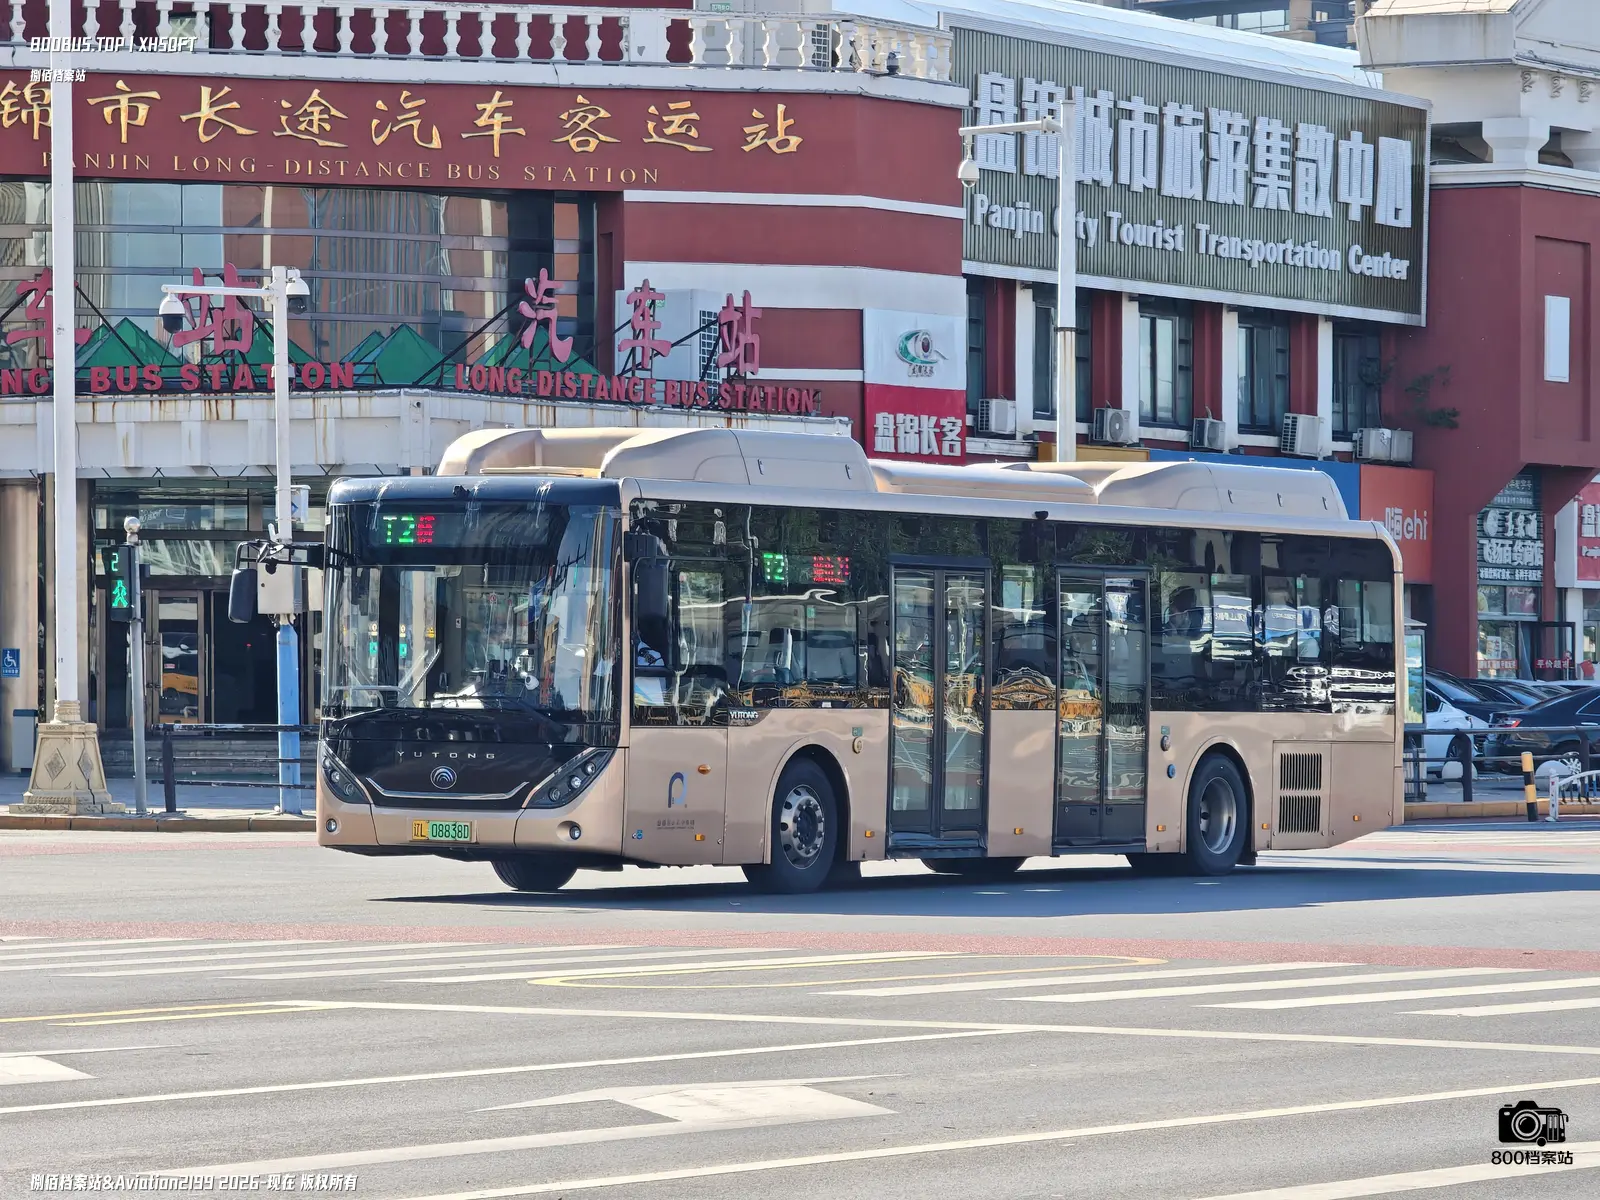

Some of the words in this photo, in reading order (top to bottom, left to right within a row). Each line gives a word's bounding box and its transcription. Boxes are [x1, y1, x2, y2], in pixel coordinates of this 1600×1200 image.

[0, 80, 803, 158] 锦市长途汽车客运站
[974, 72, 1412, 228] 盘锦城市旅游集散中心
[42, 152, 150, 170] PNJIN
[447, 163, 501, 181] BUS
[524, 166, 660, 184] STATION
[973, 193, 1044, 239] Panjin
[1052, 206, 1098, 248] Cty
[1107, 211, 1184, 253] Tourist
[1196, 223, 1341, 271] Transportation
[1348, 245, 1409, 280] Center
[518, 268, 762, 376] 汽车站
[90, 364, 163, 393] BUS
[180, 362, 355, 391] STATON
[665, 380, 709, 407] BUS
[717, 383, 818, 413] STATION
[874, 412, 963, 457] 盘锦长客
[383, 515, 415, 543] T2
[729, 711, 759, 720] YUTONG
[397, 751, 495, 760] YUTONG
